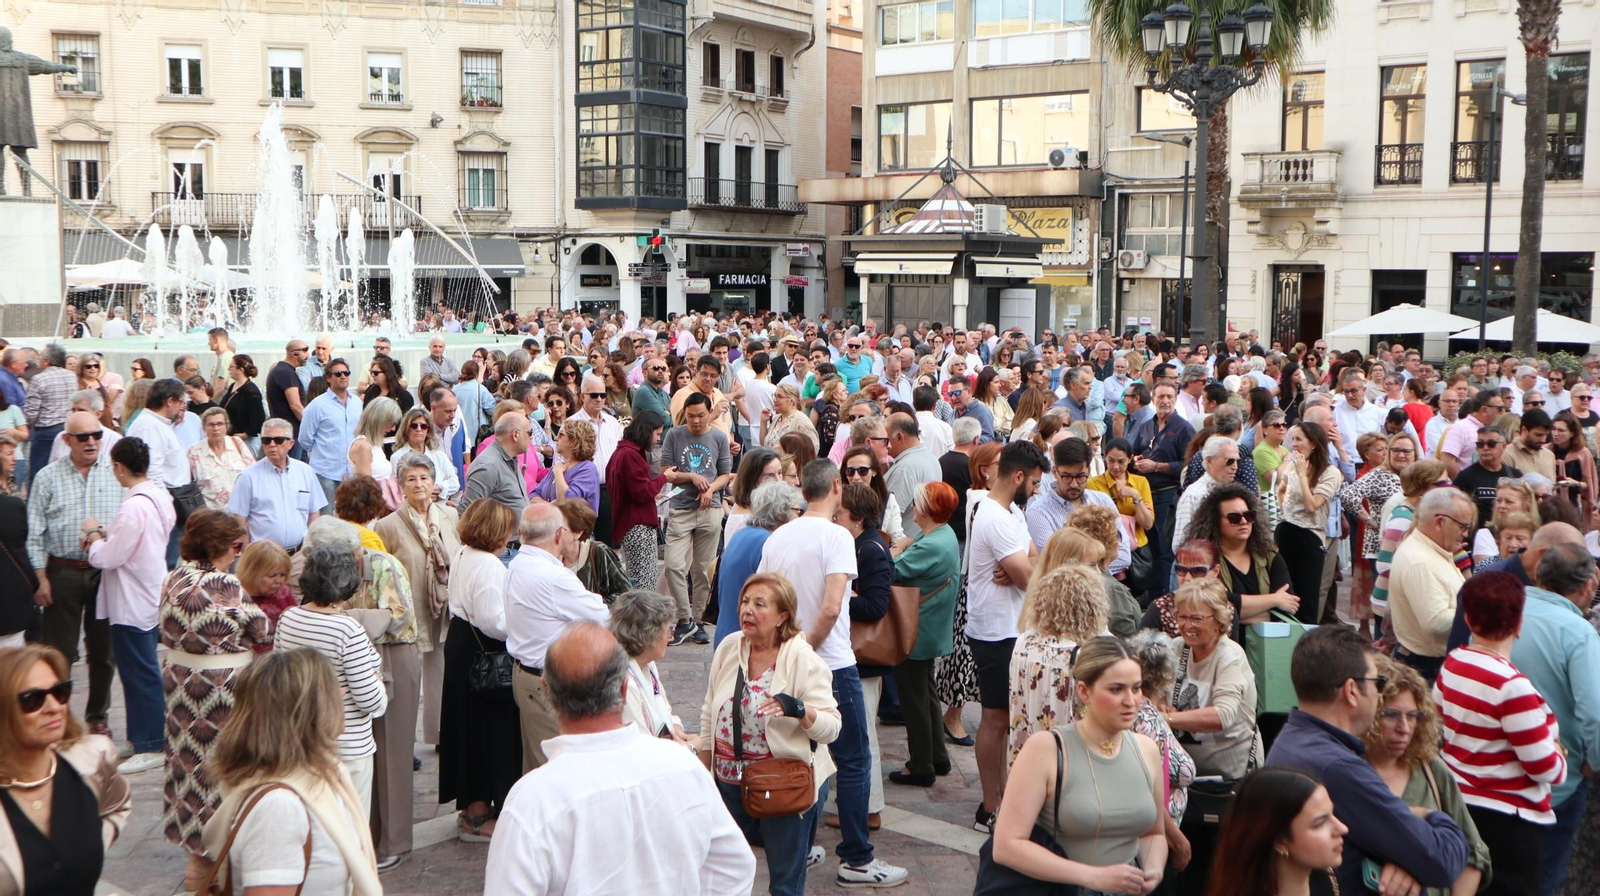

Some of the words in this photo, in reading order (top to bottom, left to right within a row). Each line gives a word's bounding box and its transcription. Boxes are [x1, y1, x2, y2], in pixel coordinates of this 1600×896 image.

[1386, 82, 1411, 92] Inglés
[1007, 210, 1070, 230] Plaza
[719, 274, 767, 285] FARMACIA
